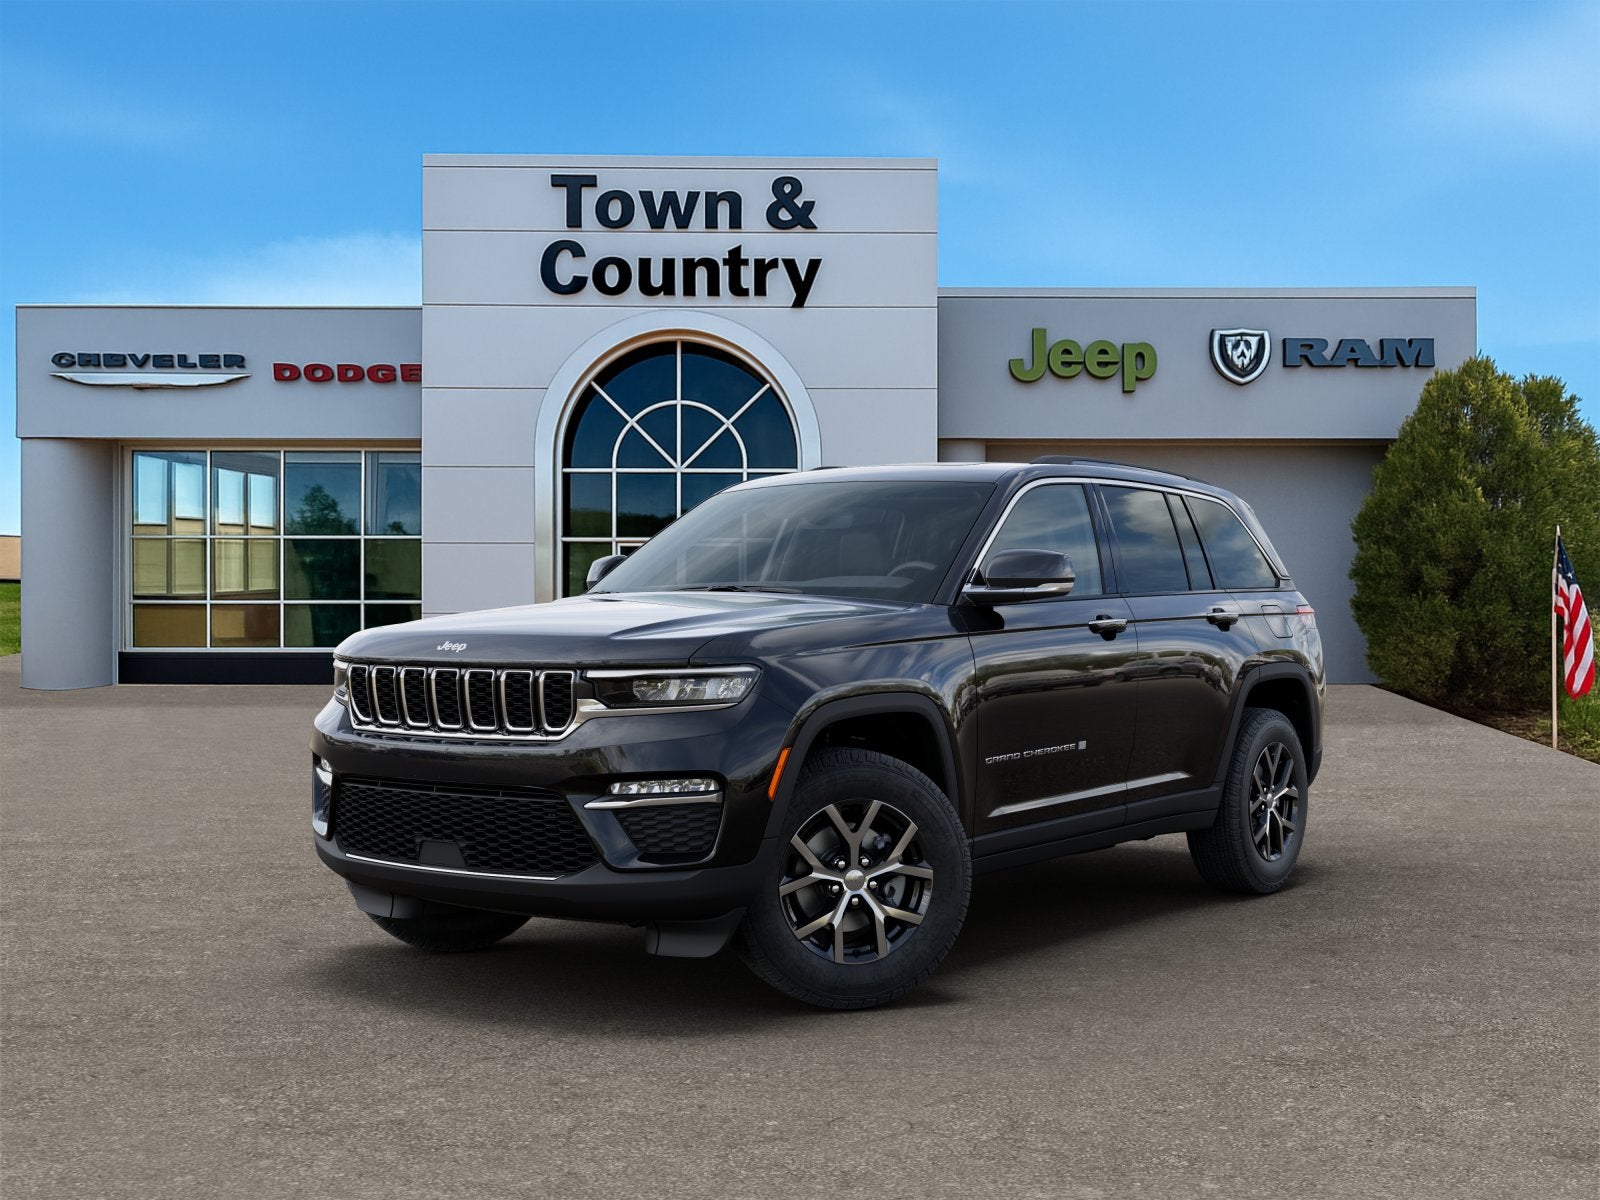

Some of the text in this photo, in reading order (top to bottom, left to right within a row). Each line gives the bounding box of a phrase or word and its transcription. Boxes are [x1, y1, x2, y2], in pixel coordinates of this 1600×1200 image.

[550, 174, 818, 230] Town &
[539, 239, 823, 308] Country
[1009, 327, 1157, 392] Jeep
[1283, 337, 1435, 367] RAM
[273, 363, 422, 382] DODGE
[437, 641, 467, 653] Jeep
[985, 743, 1076, 764] GRAND CHEROKEE
